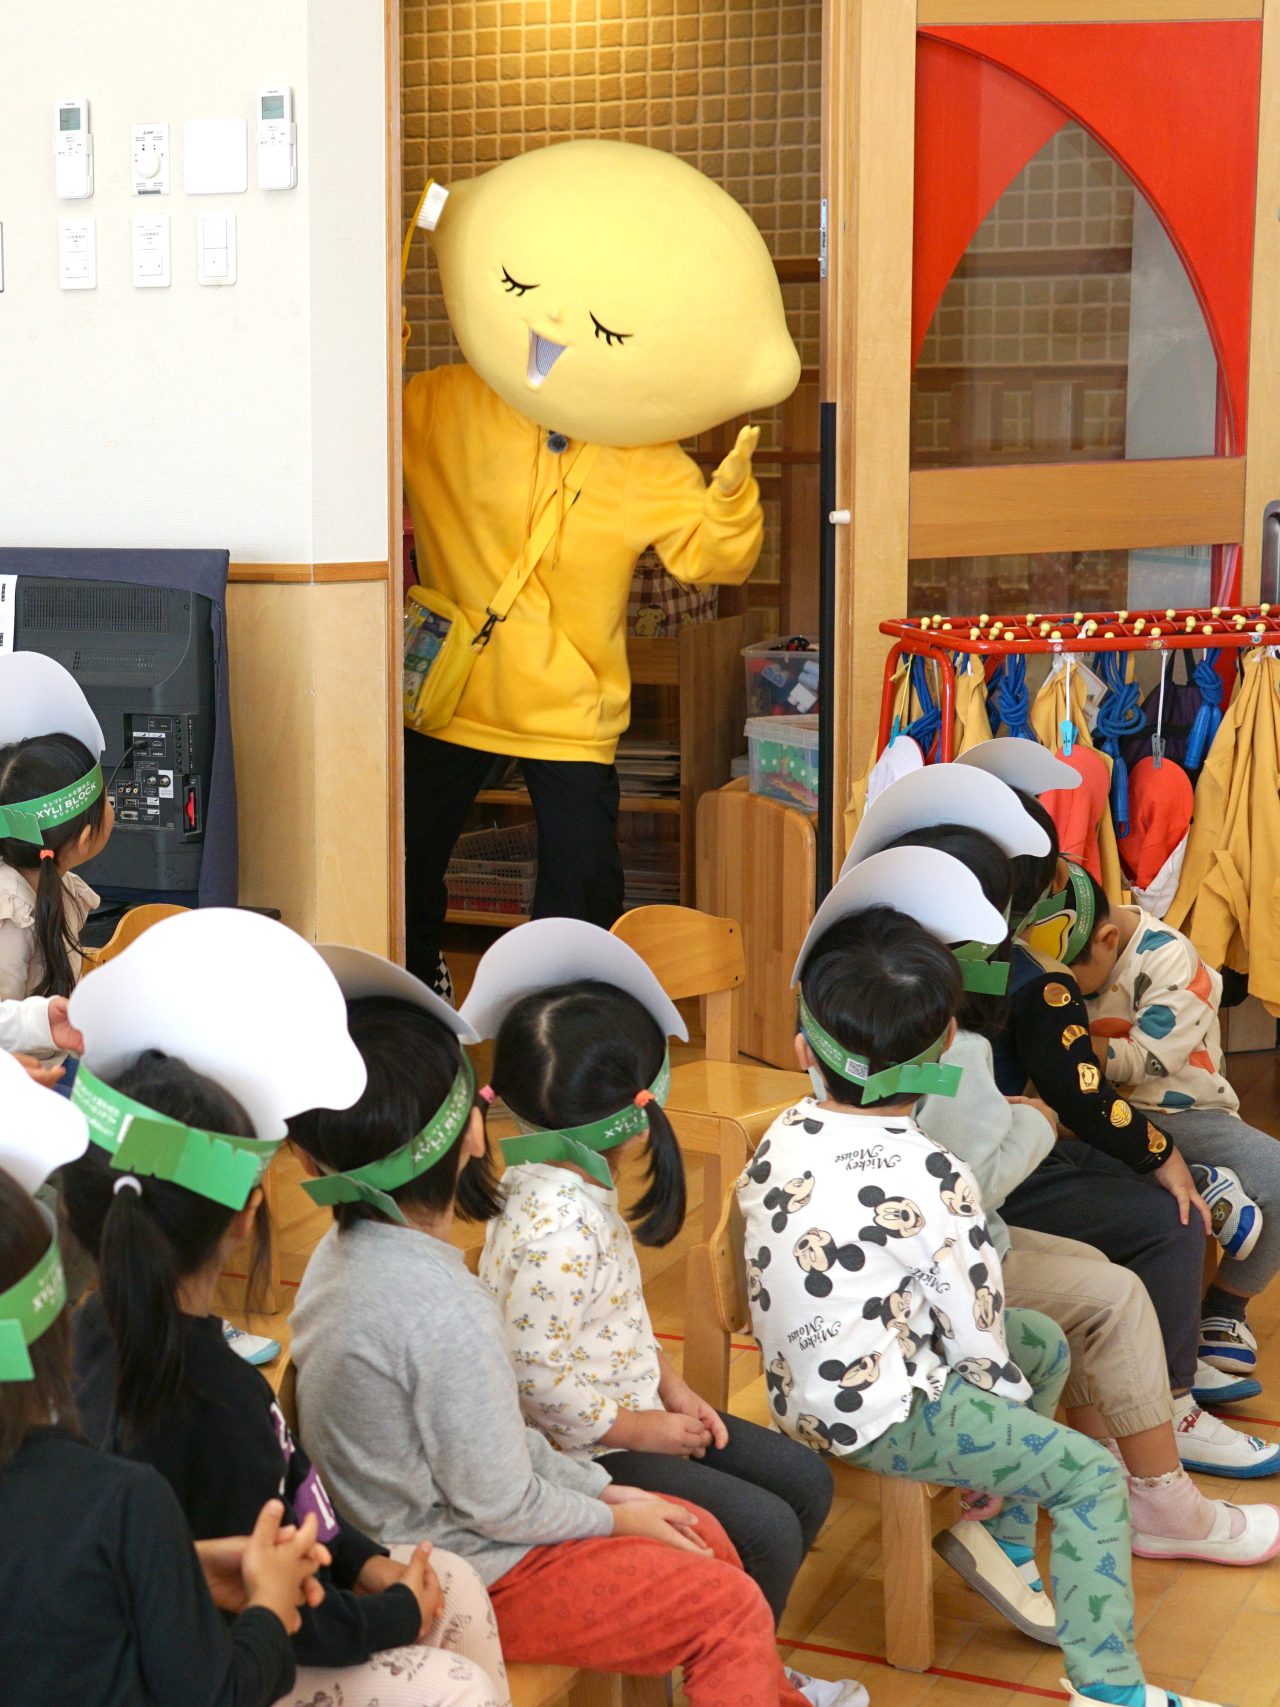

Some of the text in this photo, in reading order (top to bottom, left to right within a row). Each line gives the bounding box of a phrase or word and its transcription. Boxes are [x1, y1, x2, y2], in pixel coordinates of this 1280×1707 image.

[36, 781, 97, 820] XYLI BLOCK
[604, 1116, 638, 1138] XYLI
[834, 1144, 885, 1164] Mouse
[845, 1154, 902, 1172] Mickey
[787, 1315, 824, 1344] Mouse
[799, 1320, 842, 1352] Mickey
